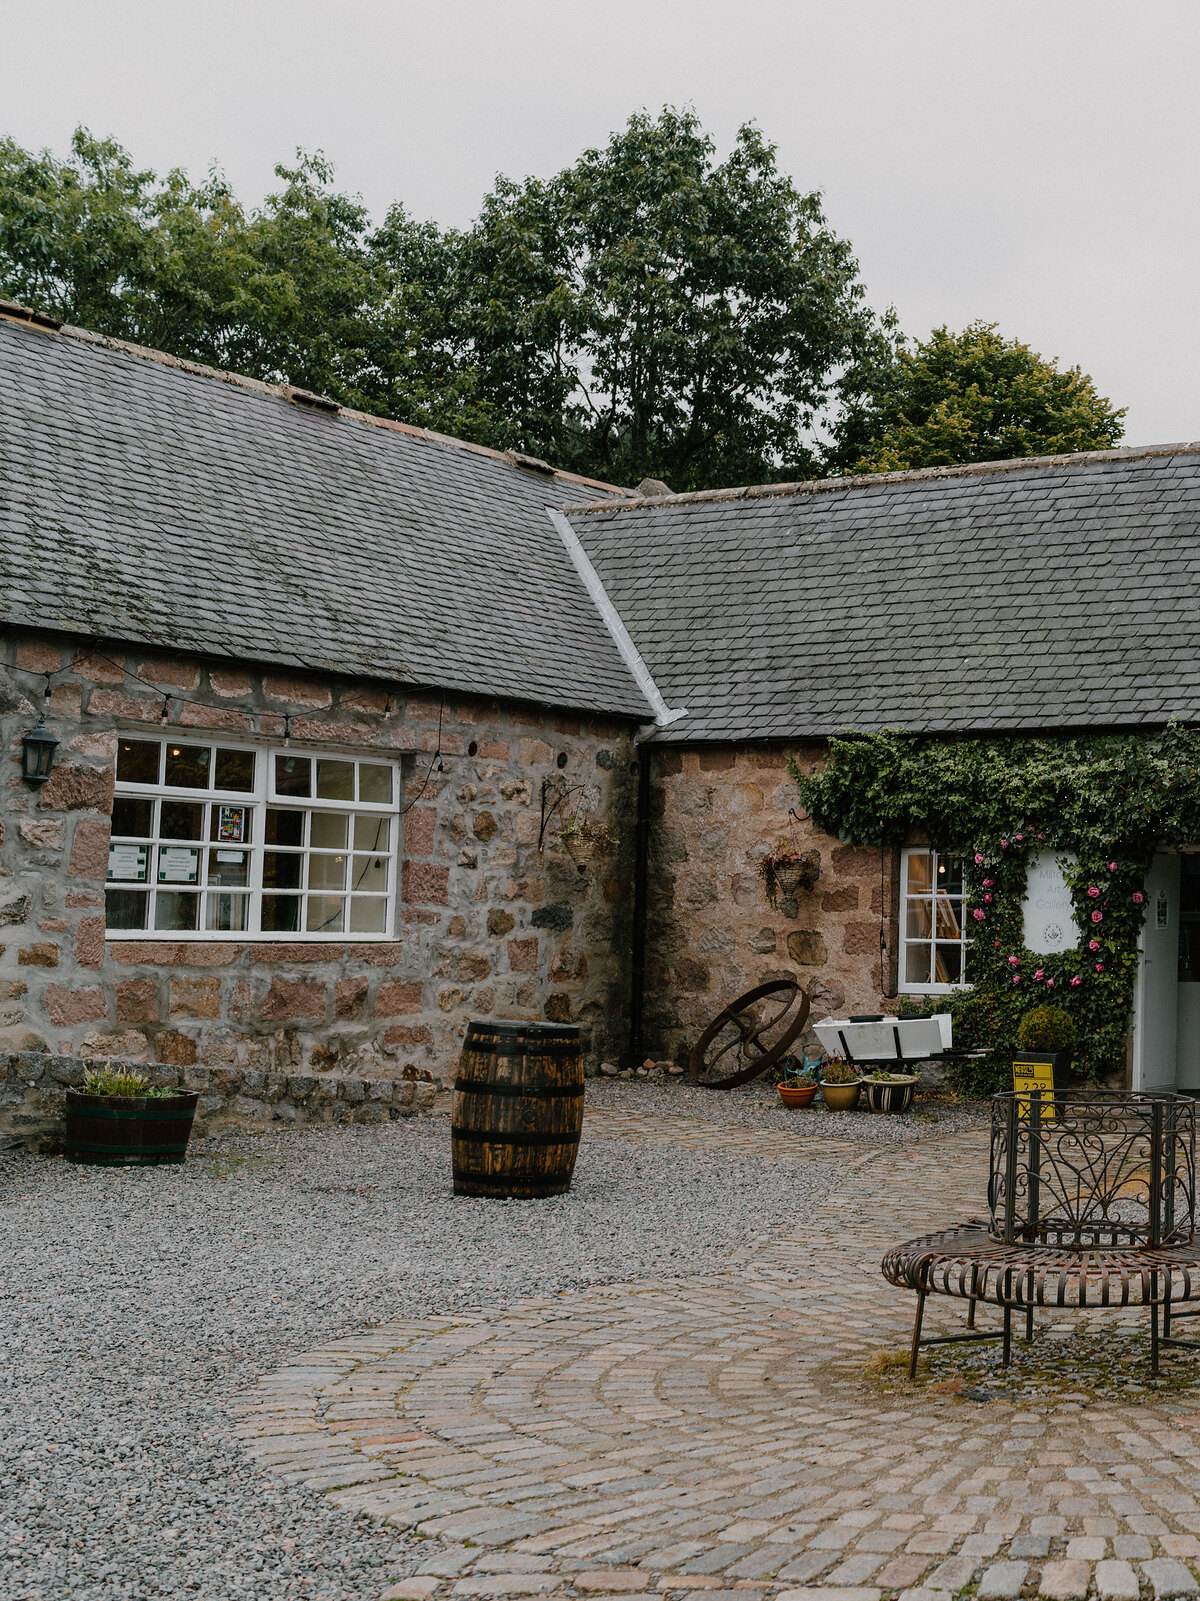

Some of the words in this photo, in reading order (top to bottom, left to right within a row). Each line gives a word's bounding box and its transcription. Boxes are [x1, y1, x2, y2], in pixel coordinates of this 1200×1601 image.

[1040, 869, 1063, 880] Milto
[1047, 886, 1061, 894] Art
[1036, 899, 1070, 911] Gallery
